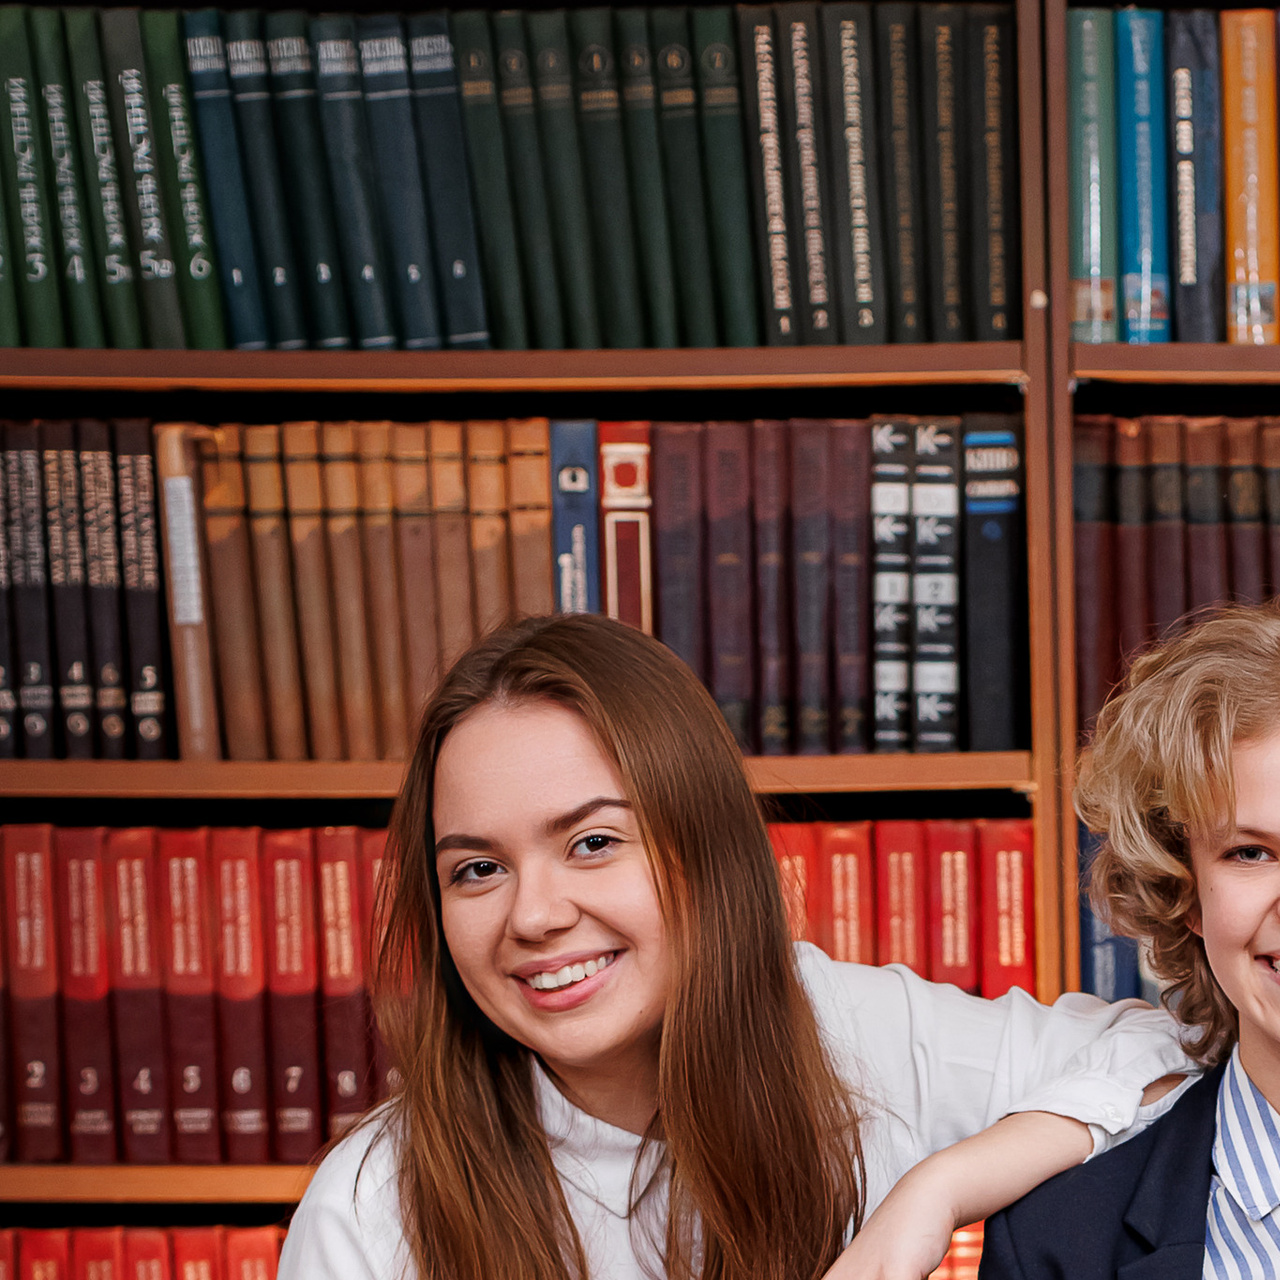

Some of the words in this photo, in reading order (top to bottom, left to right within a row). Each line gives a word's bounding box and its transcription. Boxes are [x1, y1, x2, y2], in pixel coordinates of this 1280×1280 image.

[25, 253, 47, 282] 3
[65, 255, 86, 283] 4
[189, 252, 211, 280] 6
[68, 662, 83, 682] 4
[142, 665, 157, 688] 5
[26, 1061, 46, 1088] 2
[80, 1067, 98, 1095] 3
[183, 1065, 201, 1093] 5
[285, 1066, 303, 1093] 7
